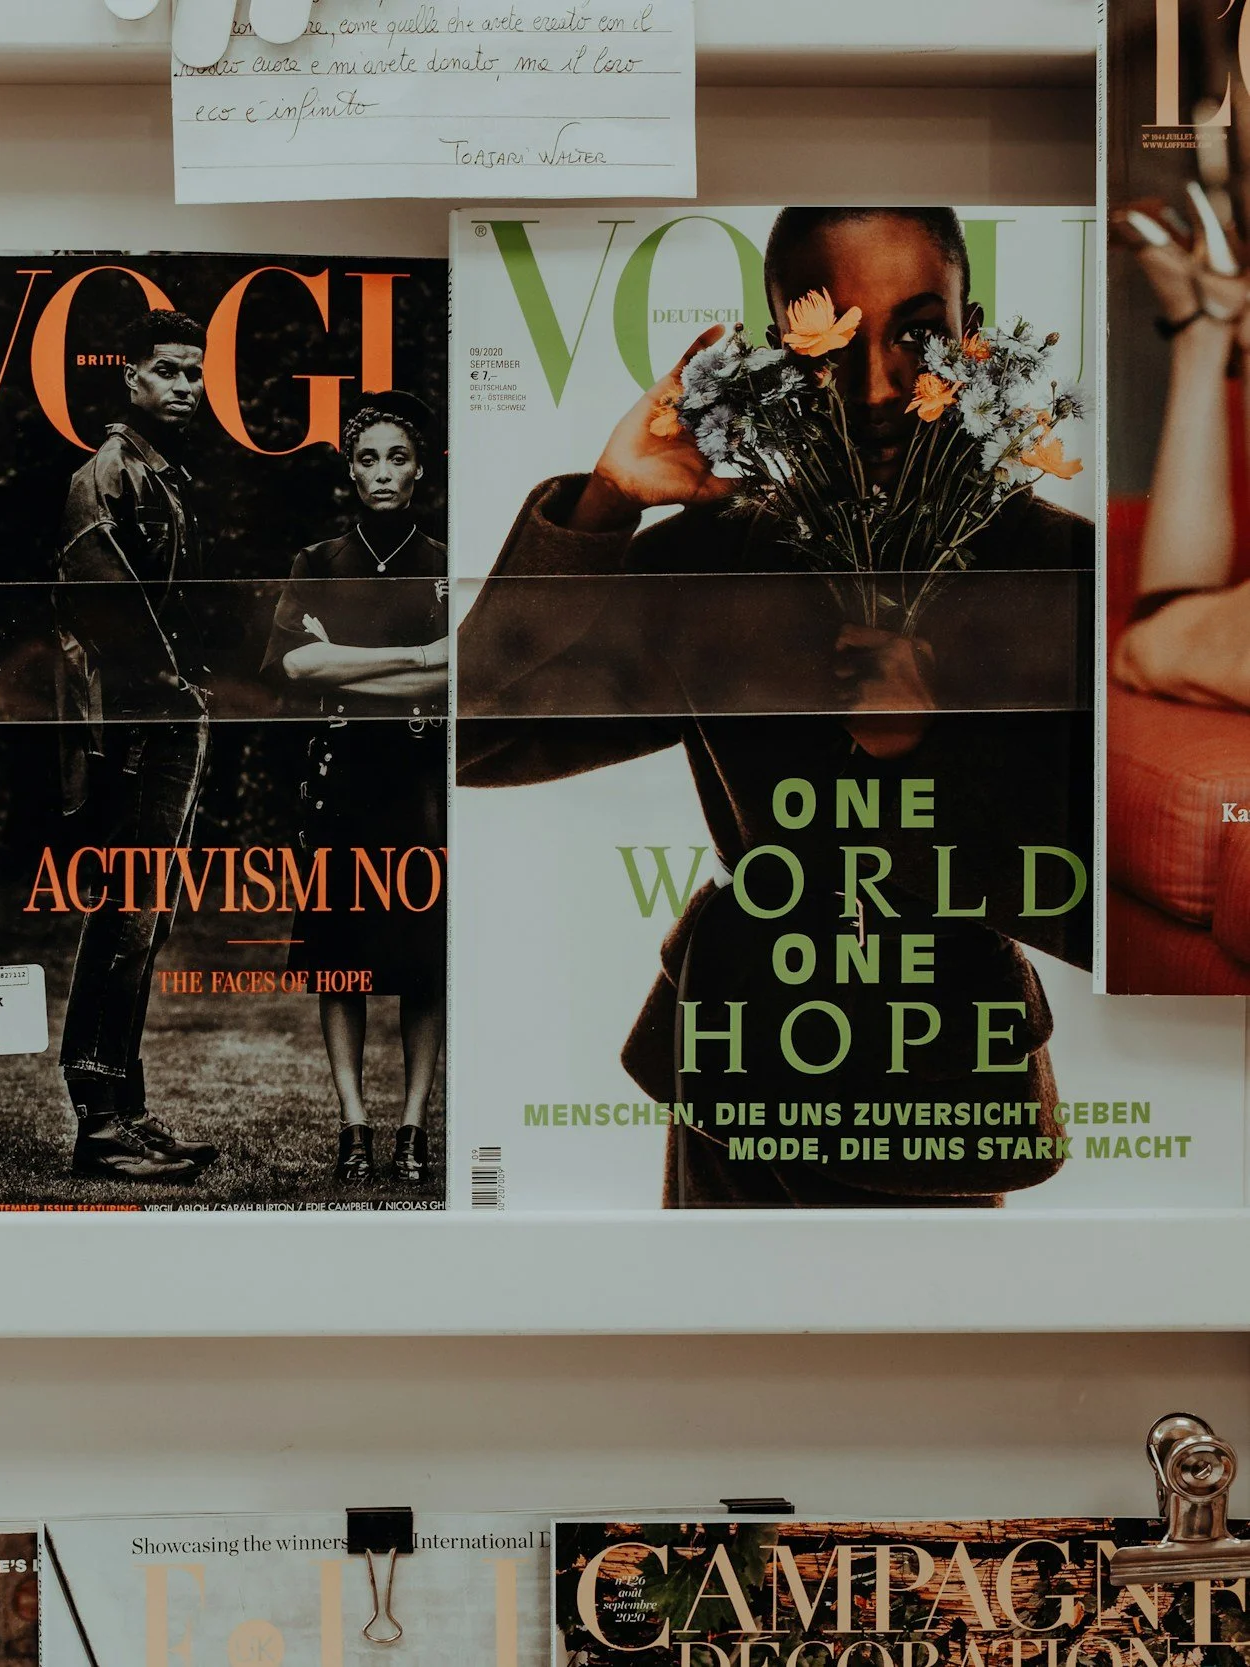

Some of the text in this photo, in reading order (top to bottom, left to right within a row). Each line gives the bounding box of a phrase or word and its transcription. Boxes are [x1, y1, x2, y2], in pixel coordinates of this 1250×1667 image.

[634, 4, 653, 31] il
[561, 44, 587, 74] il
[196, 104, 237, 121] eco
[652, 308, 740, 323] DEUTSCH
[469, 348, 503, 357] 09/2020
[469, 360, 521, 369] SEPTEMBER
[470, 371, 479, 380] €
[469, 384, 518, 392] DEUTSCHLAND
[469, 404, 526, 412] SFR SCHWEIZ
[772, 778, 936, 829] ONE
[23, 846, 448, 913] ACTIVISM NO
[616, 843, 1088, 920] WORLD
[772, 933, 936, 986] ONE
[157, 970, 373, 994] THE FACES OF HOPE
[679, 1000, 1031, 1076] HOPE
[524, 1102, 1152, 1129] MENSCHEN, DIE UNS ZUVERSICHT GEBEN
[728, 1136, 1193, 1165] MODE, DIE UNS STARK MACHT
[44, 1204, 74, 1212] ISSUE
[144, 1204, 174, 1212] VIRGIL
[176, 1204, 210, 1212] ABLOH
[221, 1203, 253, 1211] SARAH
[256, 1203, 295, 1211] BURTON
[306, 1203, 326, 1211] EDIE
[328, 1202, 375, 1211] CAMPBELL
[385, 1202, 428, 1211] NICOLAS
[132, 1536, 239, 1557] Showcasing
[243, 1535, 272, 1551] the
[276, 1534, 349, 1550] winners
[413, 1531, 533, 1549] International
[618, 1587, 642, 1598] août
[603, 1600, 658, 1612] septembre
[615, 1613, 646, 1623] 2020
